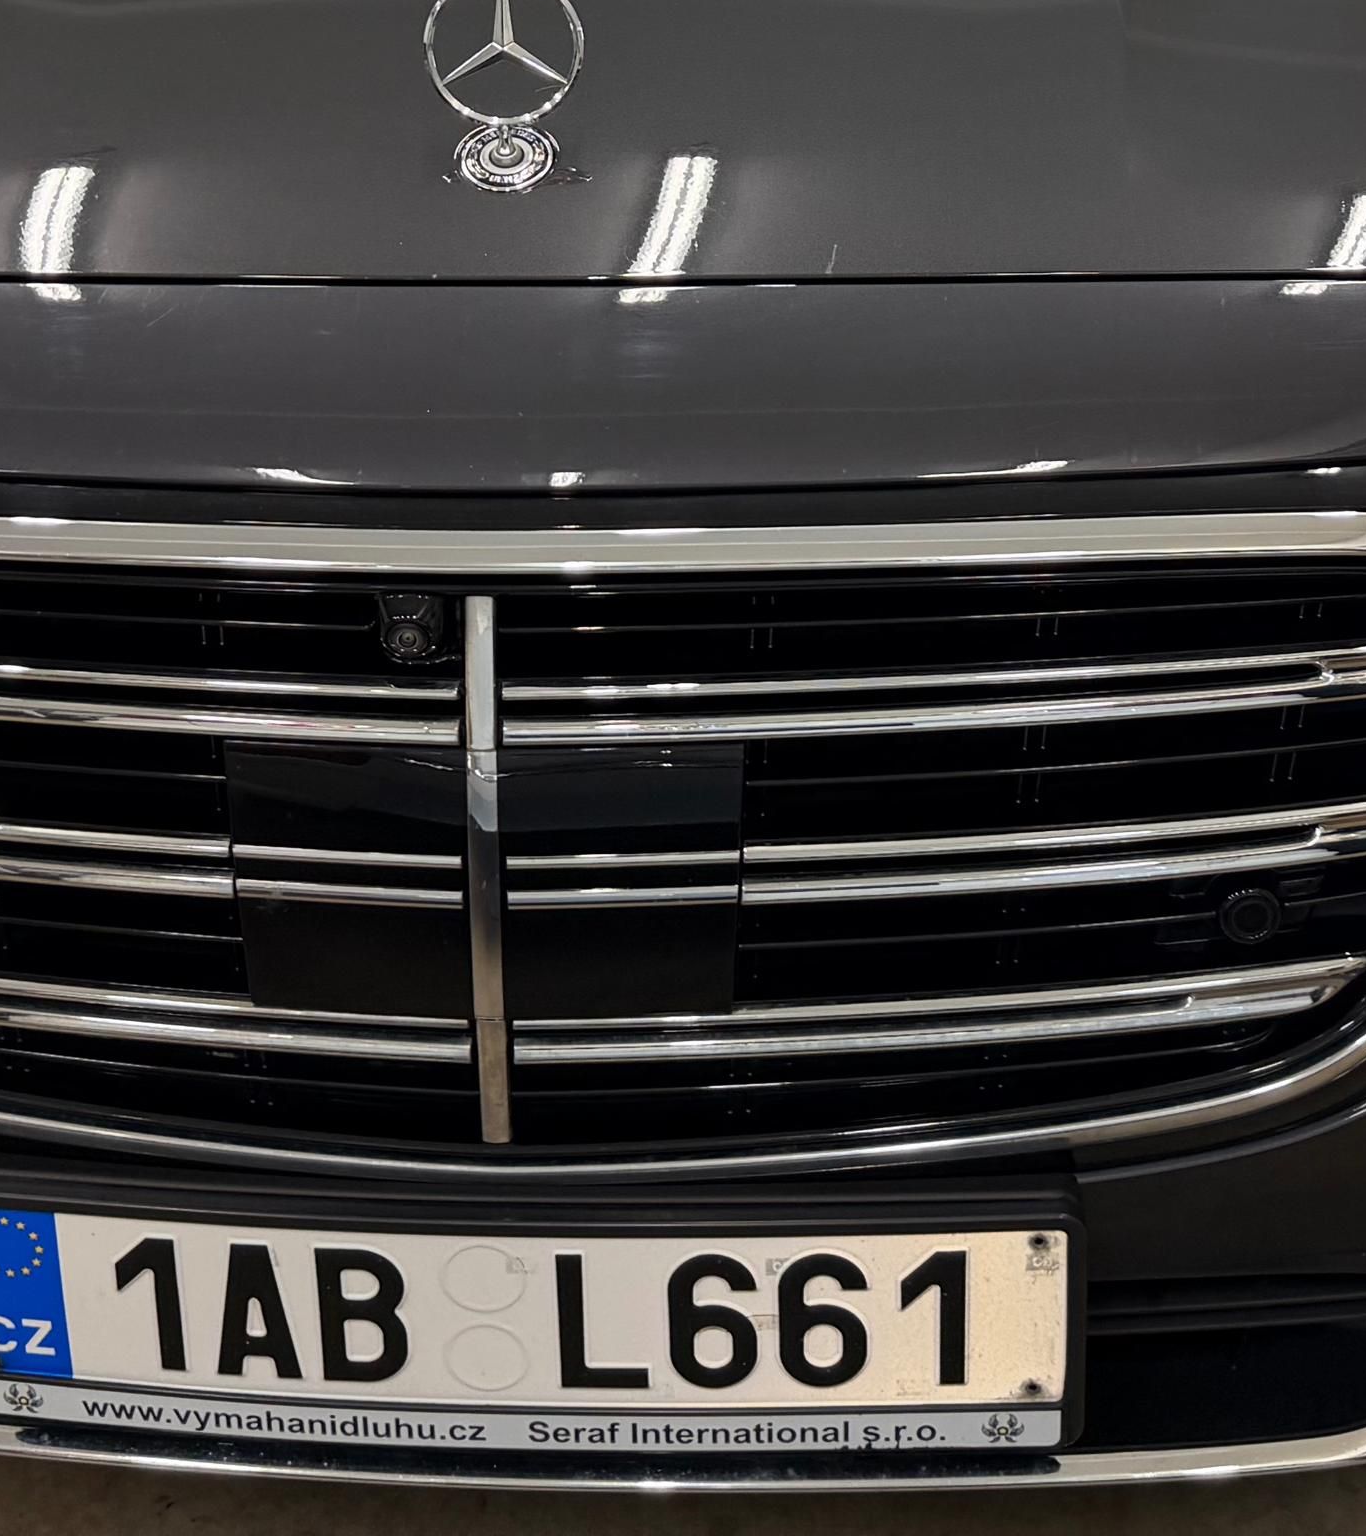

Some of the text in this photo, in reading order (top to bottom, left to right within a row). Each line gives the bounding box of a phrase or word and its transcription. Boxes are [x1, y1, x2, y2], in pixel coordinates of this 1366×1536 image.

[115, 1239, 967, 1389] 1AB L661
[82, 1400, 947, 1446] www.vymahanidluhu.cz Seraf International s.r.o.
